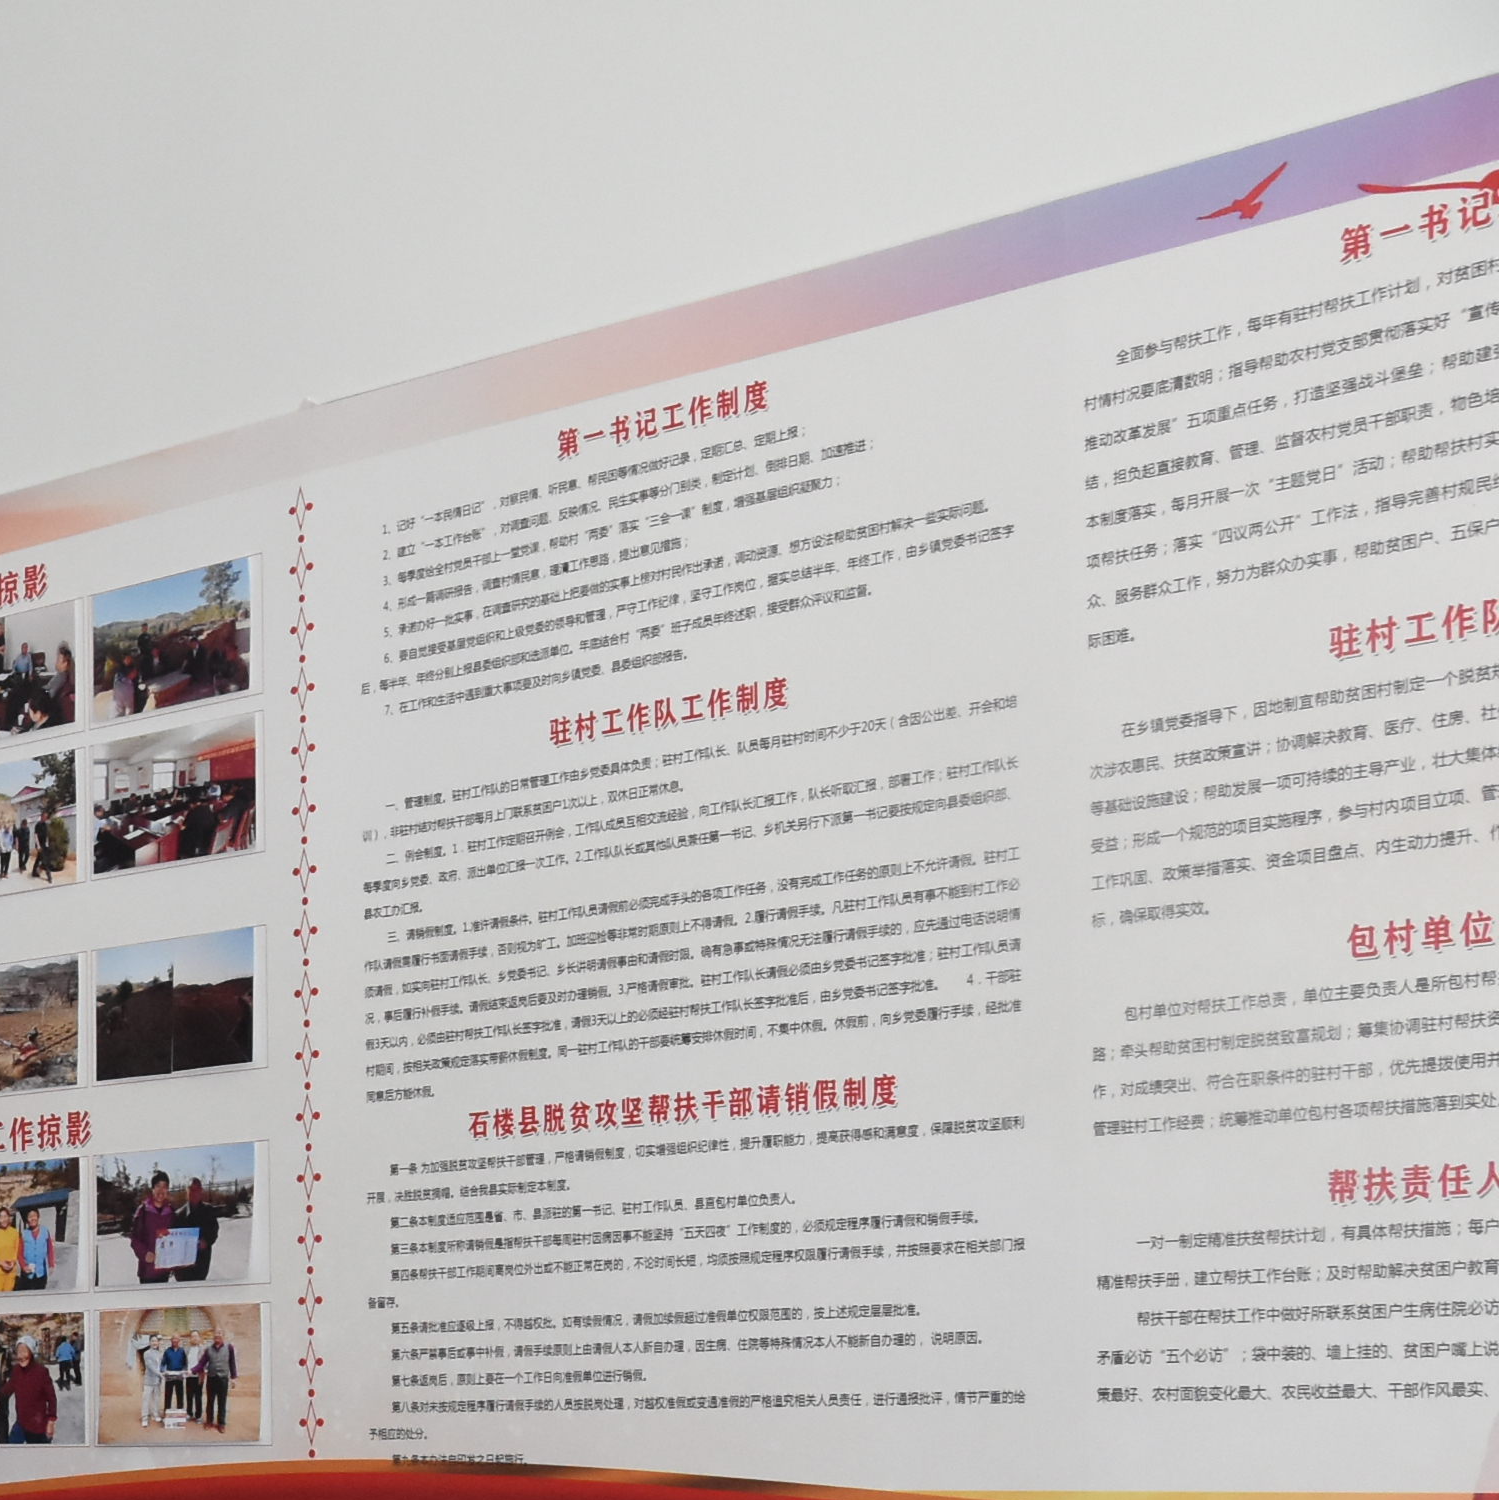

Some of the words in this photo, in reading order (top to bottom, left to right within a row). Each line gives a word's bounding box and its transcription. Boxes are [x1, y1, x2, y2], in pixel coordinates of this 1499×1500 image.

[557, 380, 769, 458] 第一书记工作制度
[1088, 627, 1135, 650] 际困难。
[549, 677, 788, 747] 驻村工作队工作制度
[1090, 704, 1499, 780] 次涉农惠民、扶贫政策宣讲；协调解决教育、医疗、住房、社
[1090, 745, 1499, 816] 等基础设施建设；帮助发展一项可持续的主导产业，壮大集体
[1090, 784, 1499, 854] 受益；形成一个规范的项目实施程序，参与村内项目立项、管
[1091, 901, 1210, 928] 标，确保取得实效。
[1347, 910, 1494, 958] 包村单位
[1124, 970, 1499, 1022] 包村单位对帮扶工作总责，单位主要负责人是所包村帮
[468, 1073, 897, 1140] 石楼县脱贫攻坚帮扶干部请销假制度
